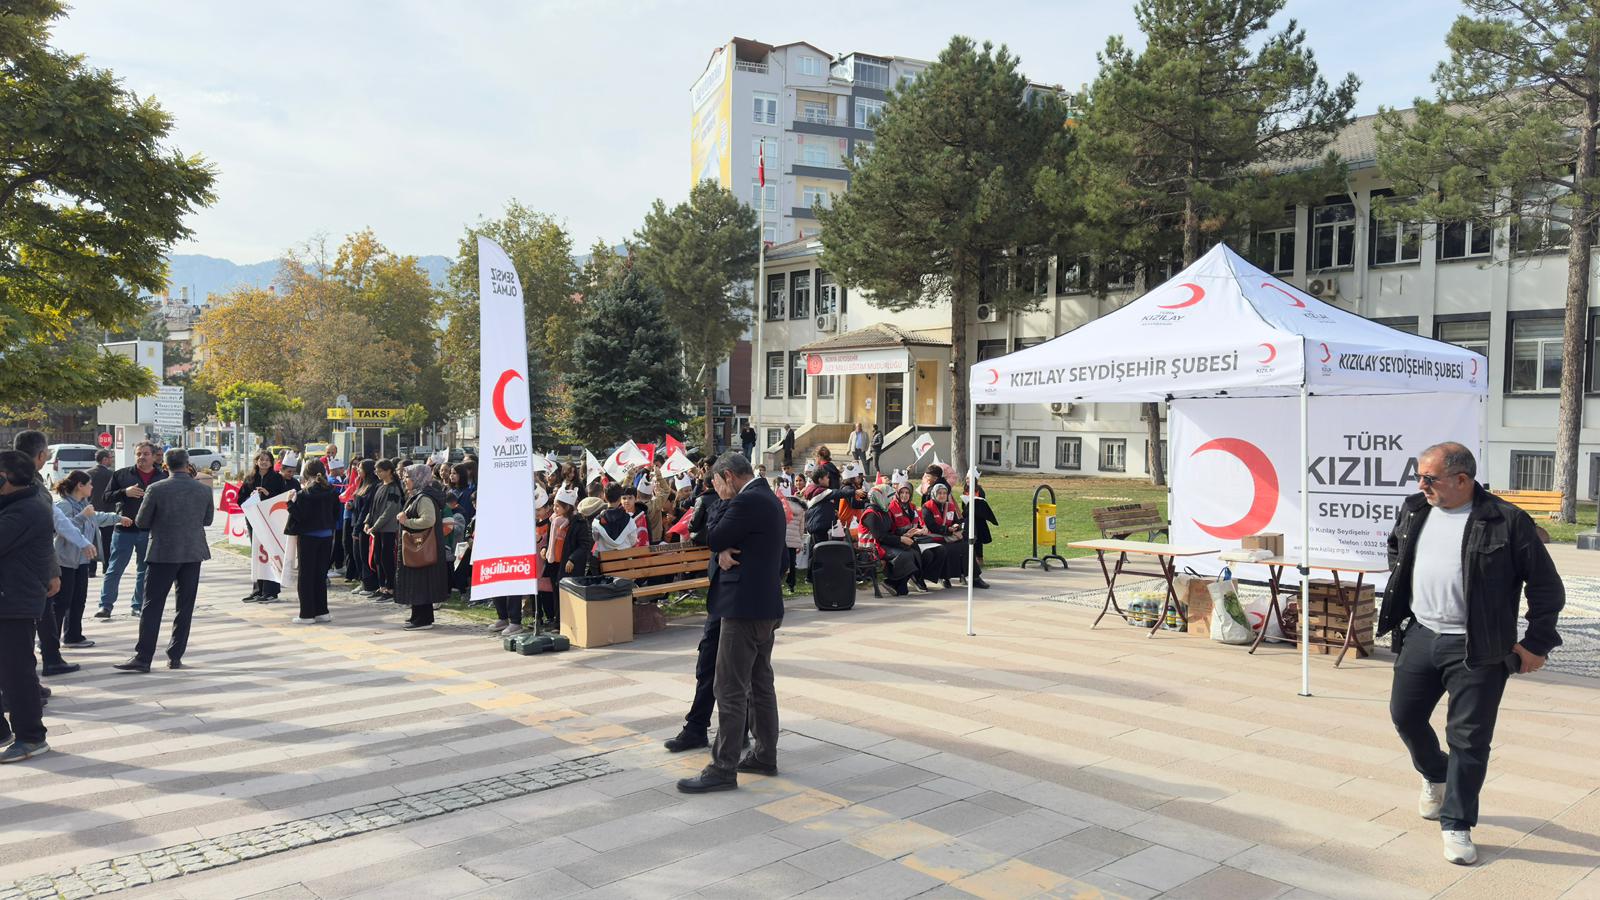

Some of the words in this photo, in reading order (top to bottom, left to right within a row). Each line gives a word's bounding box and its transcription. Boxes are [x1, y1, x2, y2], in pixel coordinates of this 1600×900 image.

[1010, 369, 1065, 387] KIZILAY
[1069, 357, 1166, 382] SEYDİŞEHİR
[1171, 350, 1238, 378] ŞUBESİ
[1339, 353, 1378, 372] KIZILAY
[1379, 354, 1433, 378] SEYDİŞEHİR
[1434, 361, 1464, 381] ŞUBESİ
[1343, 431, 1404, 451] TÜRK
[1307, 456, 1420, 487] KIZILA
[1319, 501, 1400, 523] SEYDİŞE
